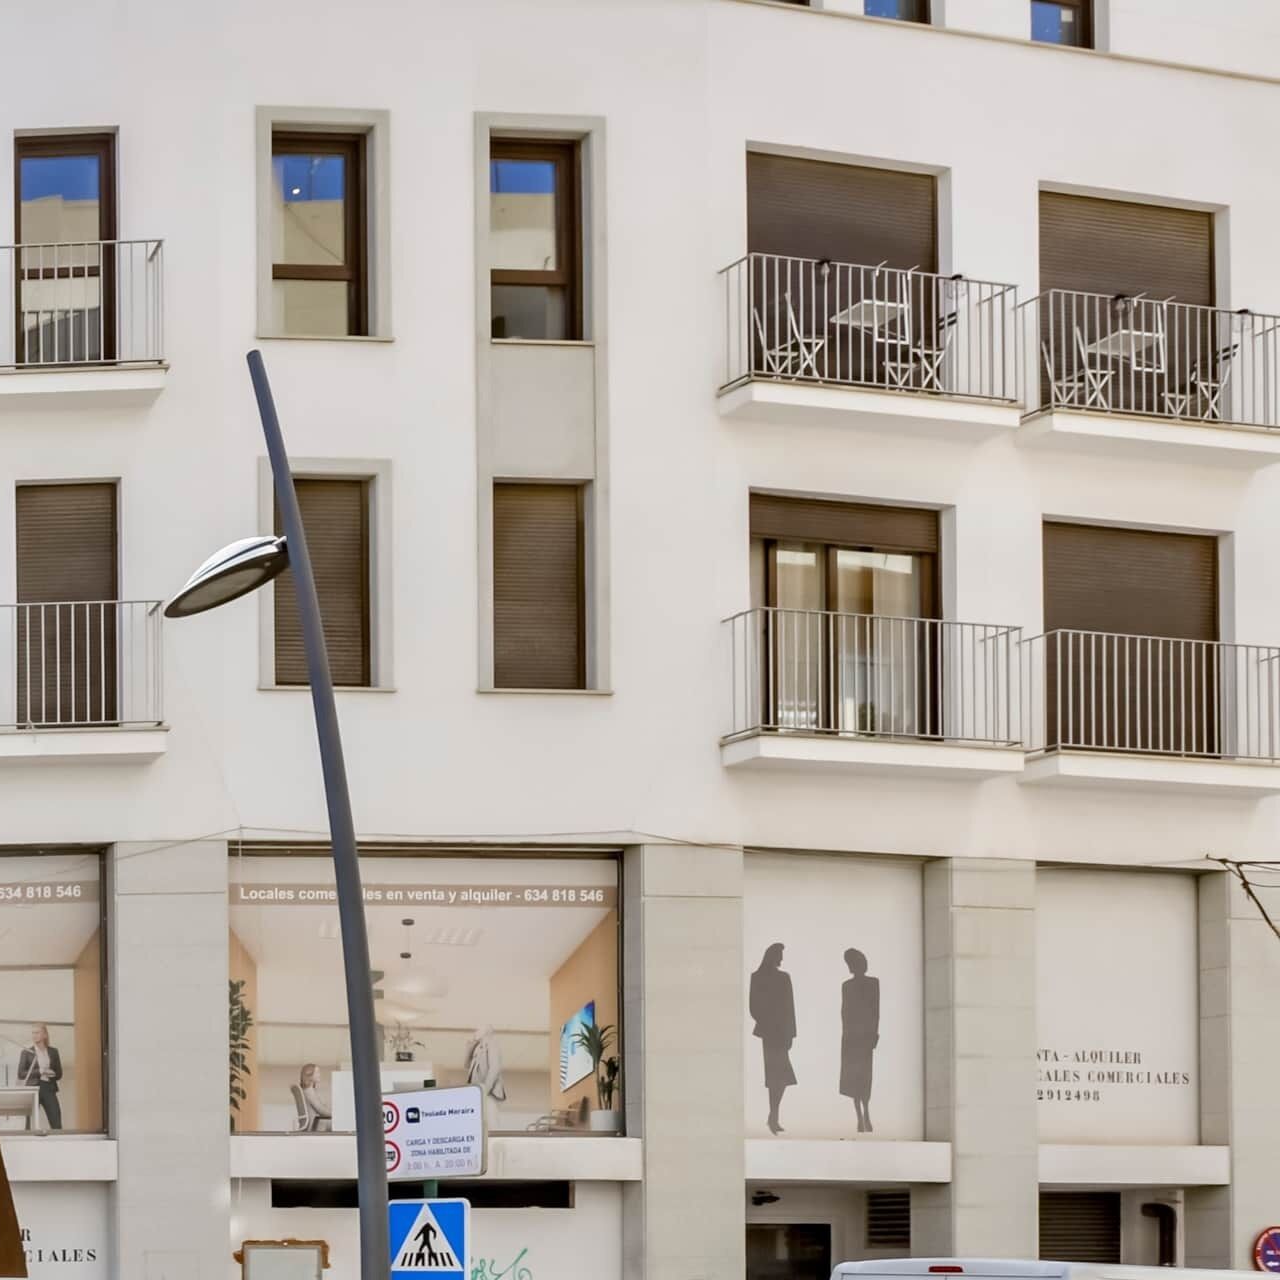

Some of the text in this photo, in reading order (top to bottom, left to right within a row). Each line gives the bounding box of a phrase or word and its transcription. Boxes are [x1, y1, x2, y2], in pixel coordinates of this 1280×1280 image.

[26, 886, 51, 898] 818
[56, 885, 81, 898] 546
[240, 887, 294, 900] Locales
[298, 887, 383, 900] comeles
[386, 889, 403, 900] en
[407, 889, 445, 900] venta
[448, 891, 457, 903] y
[461, 888, 512, 903] alquiler
[524, 888, 548, 901] 634
[552, 889, 576, 901] 818
[579, 889, 604, 902] 546
[1073, 1050, 1141, 1064] ALQUILER
[1088, 1071, 1190, 1085] COMERCIALES
